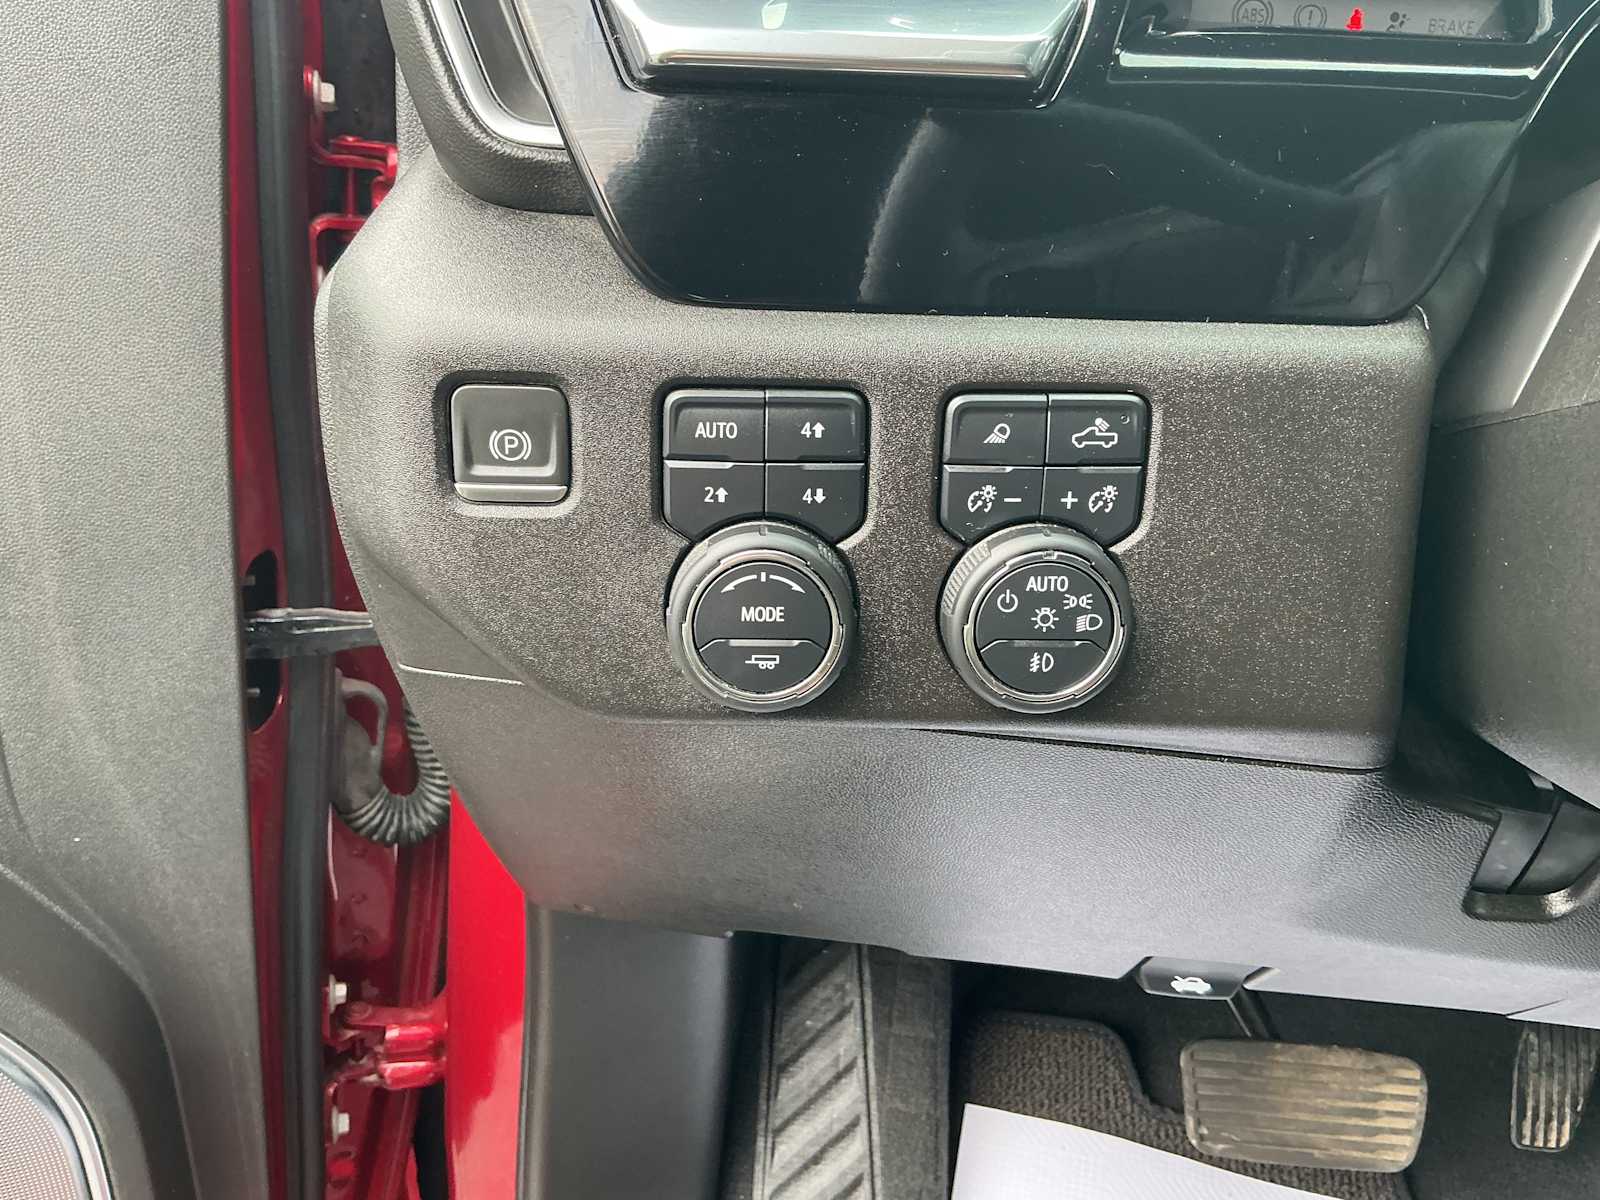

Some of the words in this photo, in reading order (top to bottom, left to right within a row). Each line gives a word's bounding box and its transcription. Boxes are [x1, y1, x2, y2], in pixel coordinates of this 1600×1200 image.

[1241, 7, 1265, 25] ABS
[1427, 18, 1477, 36] BRAKE
[694, 421, 738, 439] AUTO
[800, 421, 812, 439] 4
[504, 435, 519, 455] P
[703, 486, 715, 503] 2
[802, 487, 813, 504] 4
[1025, 575, 1069, 592] AUTO
[740, 606, 785, 622] MODE
